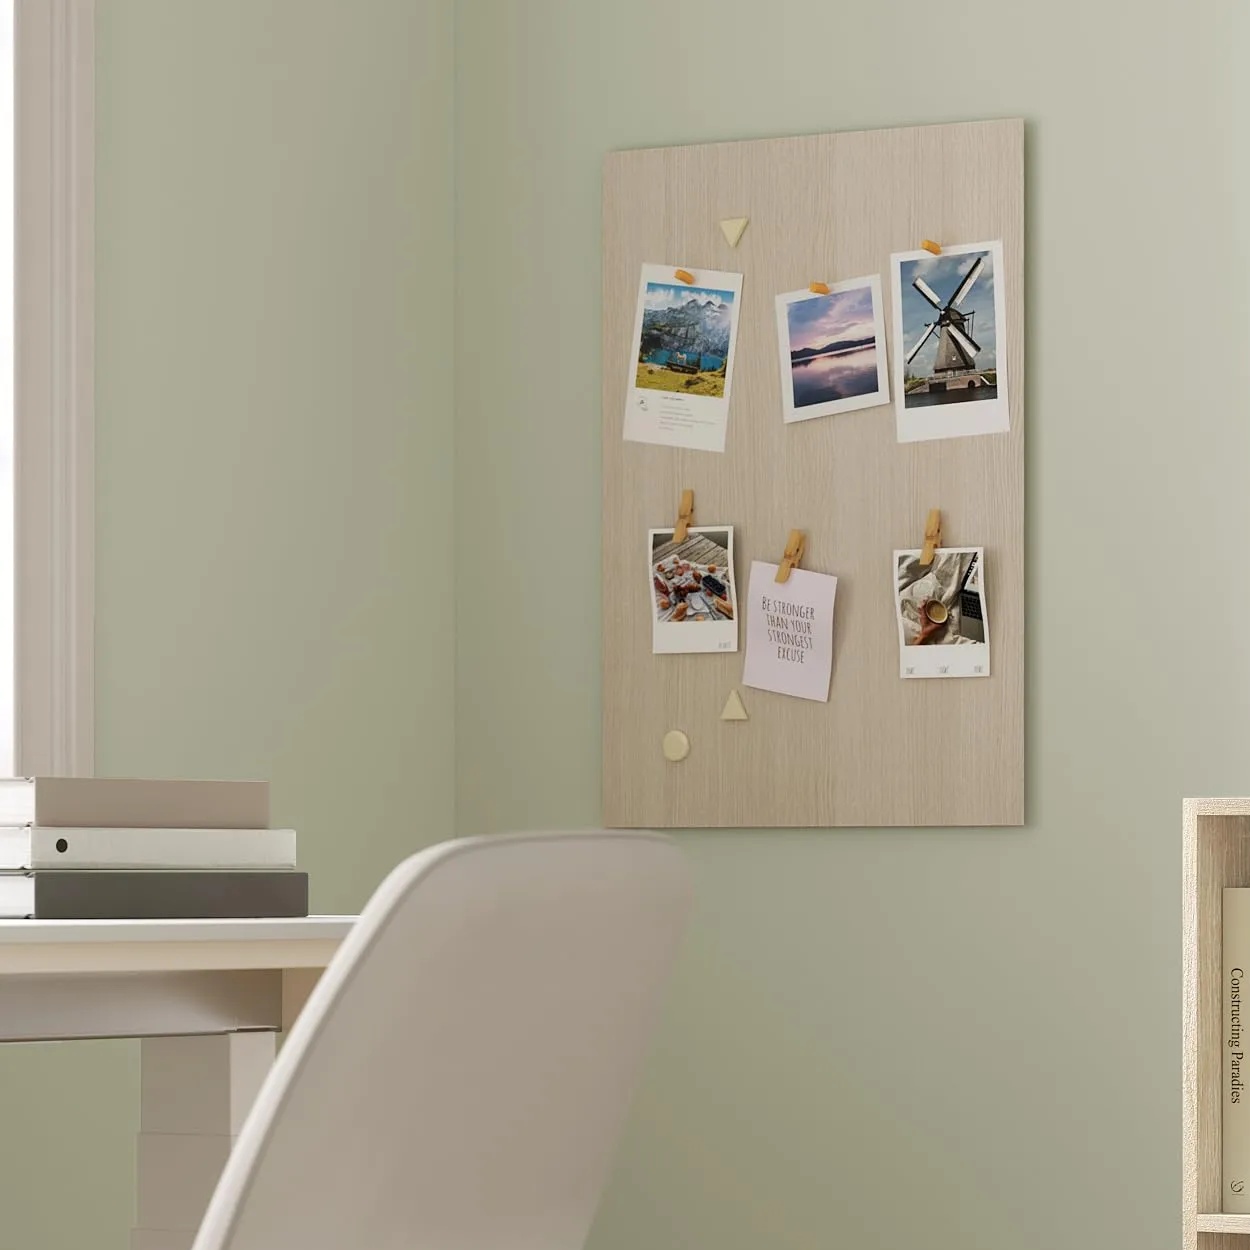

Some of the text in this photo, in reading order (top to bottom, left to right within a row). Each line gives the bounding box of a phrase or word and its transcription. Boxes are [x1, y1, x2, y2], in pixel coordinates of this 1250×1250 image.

[762, 595, 815, 620] BE STRONGER
[766, 613, 812, 634] THAN YOUR
[767, 628, 813, 649] STRONGEST
[777, 646, 804, 664] EXCUSE
[1228, 967, 1244, 1104] Constructing Paradies
